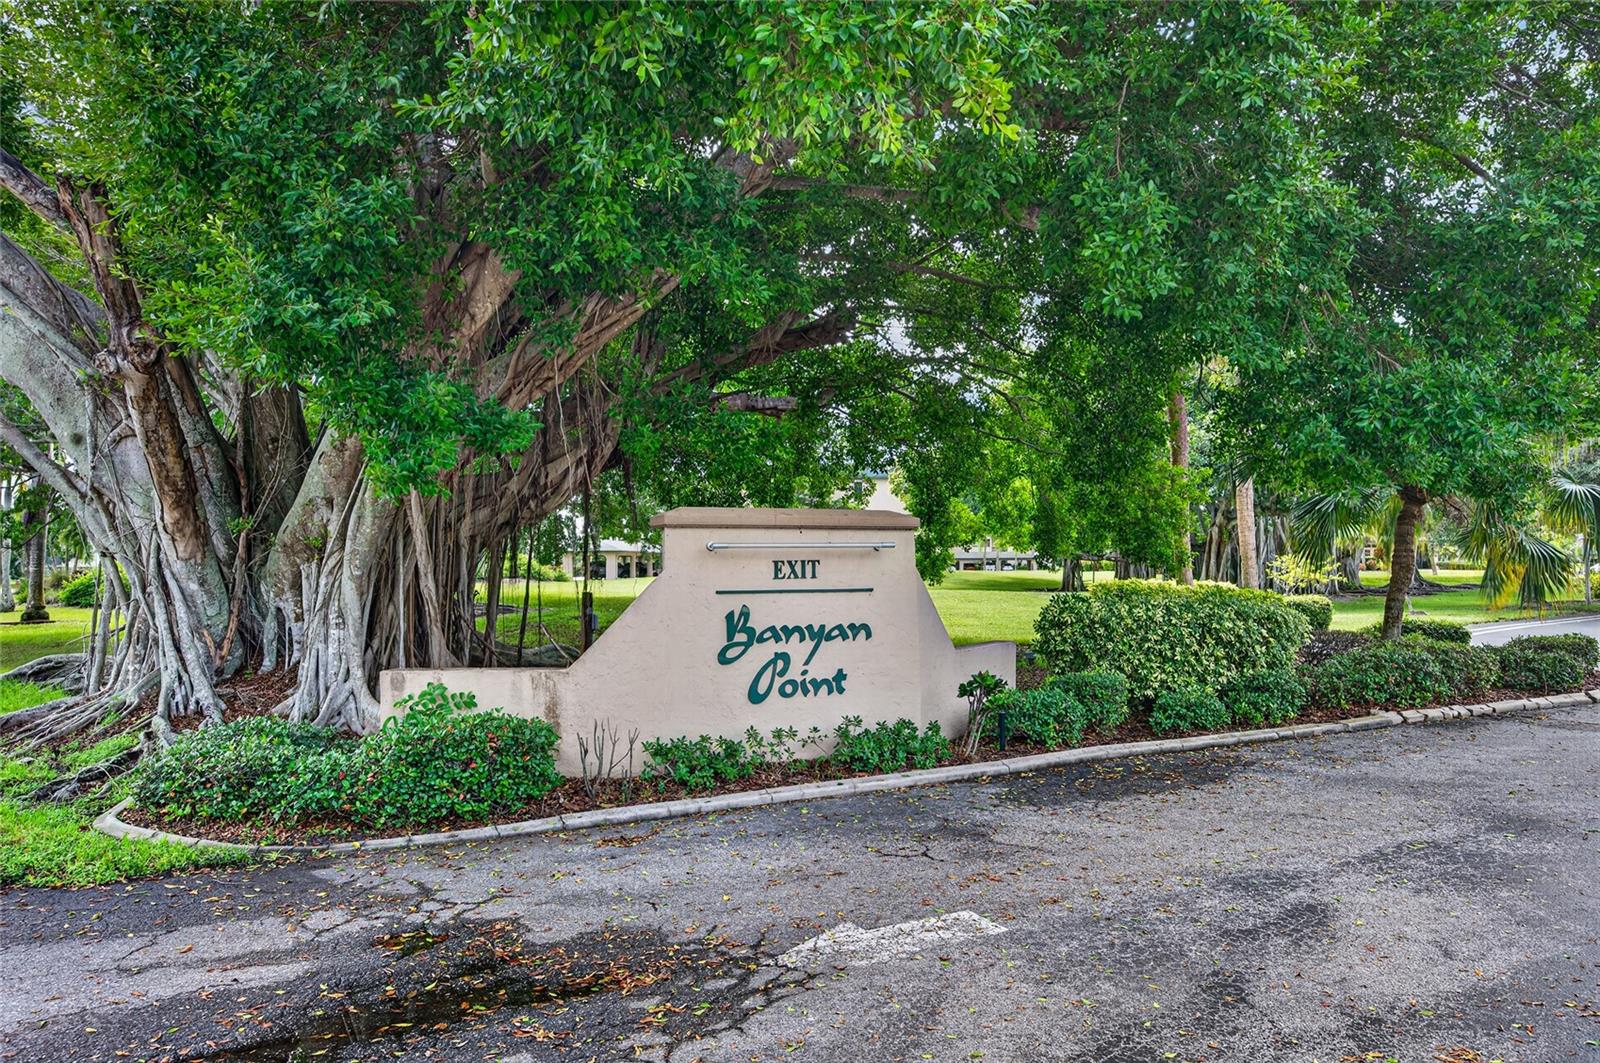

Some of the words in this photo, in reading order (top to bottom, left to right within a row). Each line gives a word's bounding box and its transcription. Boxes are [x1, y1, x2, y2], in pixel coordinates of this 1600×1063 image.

[772, 559, 821, 580] EXIT
[717, 604, 873, 666] Banyan
[747, 652, 848, 705] Point
